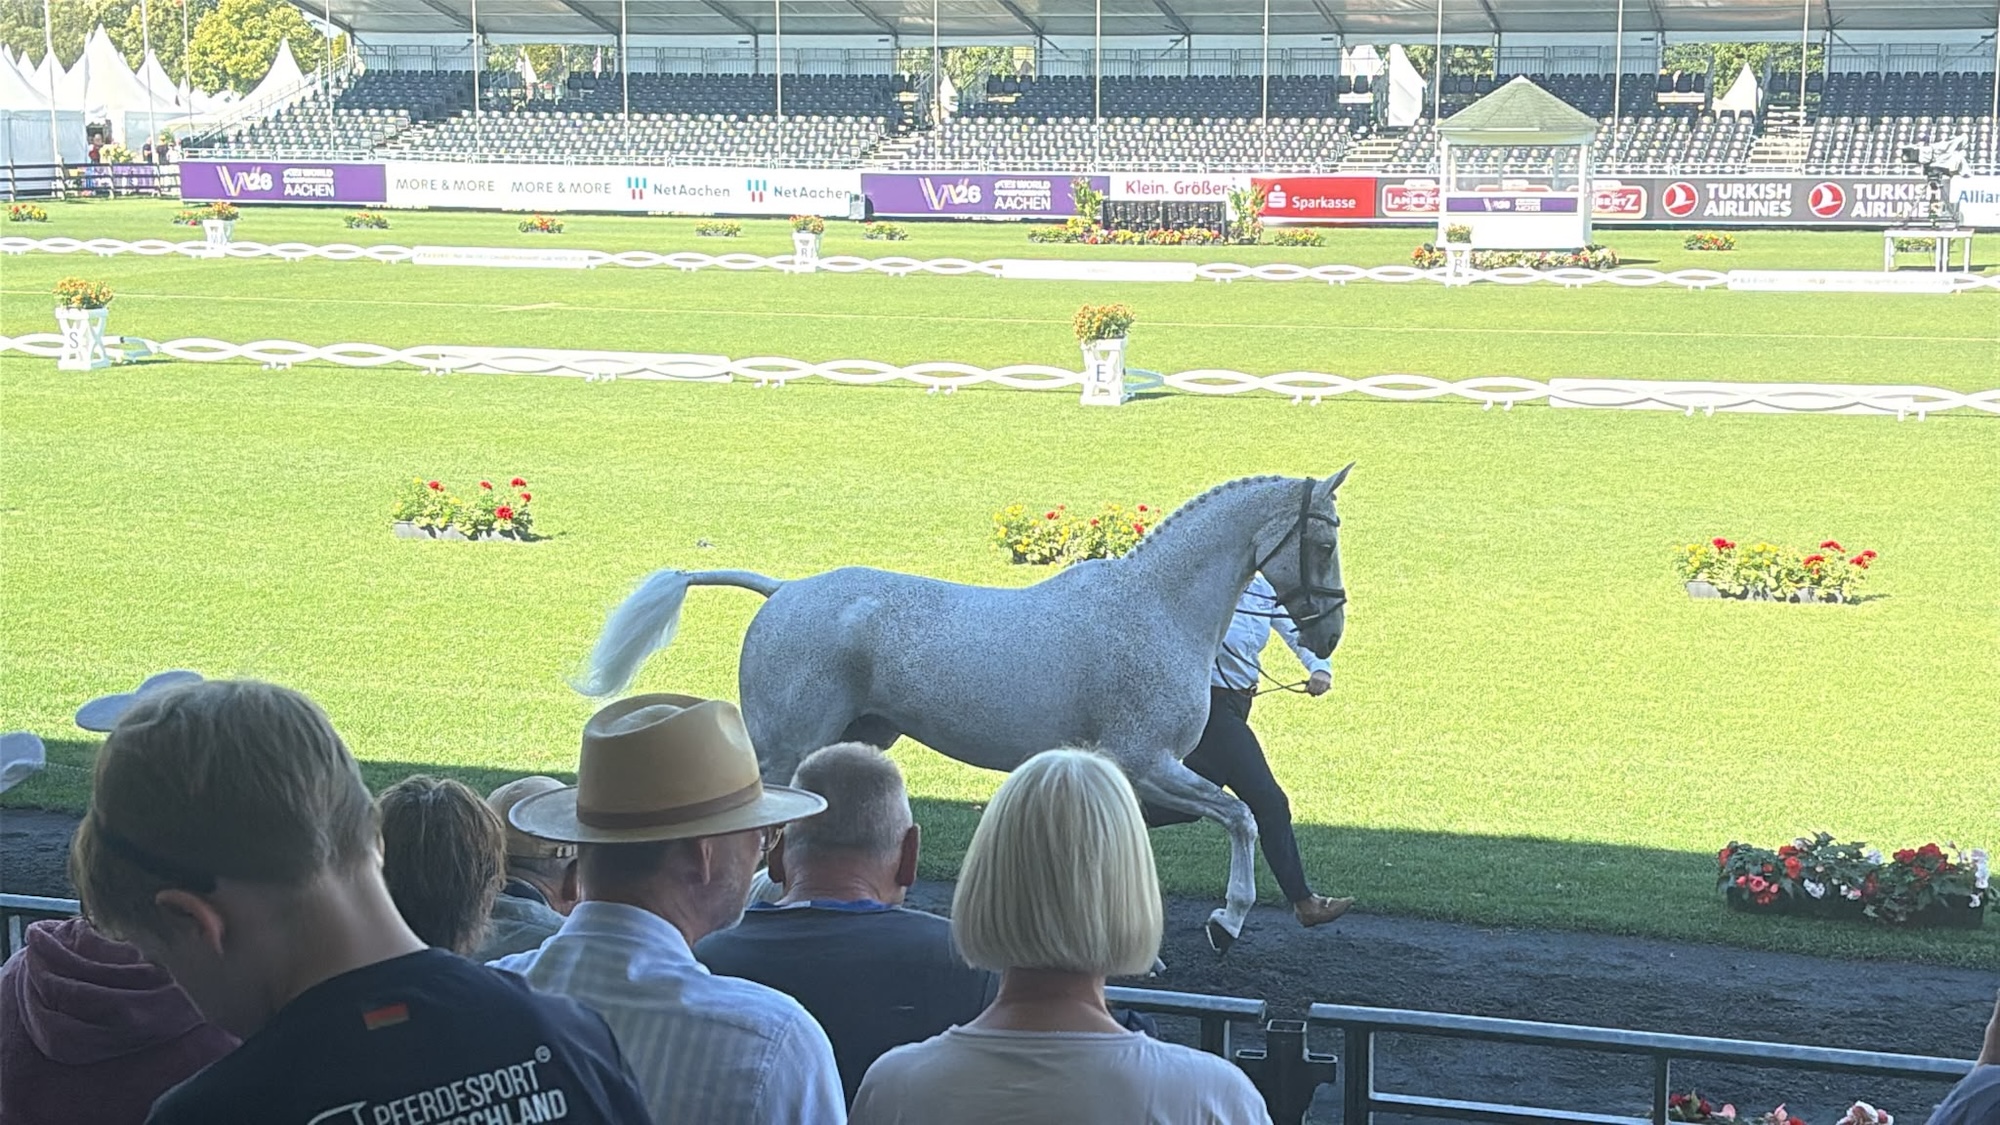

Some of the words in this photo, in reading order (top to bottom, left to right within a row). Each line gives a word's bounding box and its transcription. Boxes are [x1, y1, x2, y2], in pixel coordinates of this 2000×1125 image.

[283, 184, 335, 198] AACHEN
[396, 178, 438, 191] MORE
[441, 179, 450, 191] &
[453, 180, 495, 192] MORE
[511, 181, 553, 194] MORE
[558, 181, 566, 194] &
[569, 182, 612, 194] MORE
[653, 183, 731, 197] NetAachen
[1125, 180, 1169, 195] Klein.
[1706, 183, 1792, 200] TURKISH
[994, 197, 1051, 210] AACHEN
[1291, 196, 1357, 210] Sparkasse
[1703, 201, 1792, 217] AIRLINES
[69, 331, 79, 349] S
[1096, 363, 1107, 383] E
